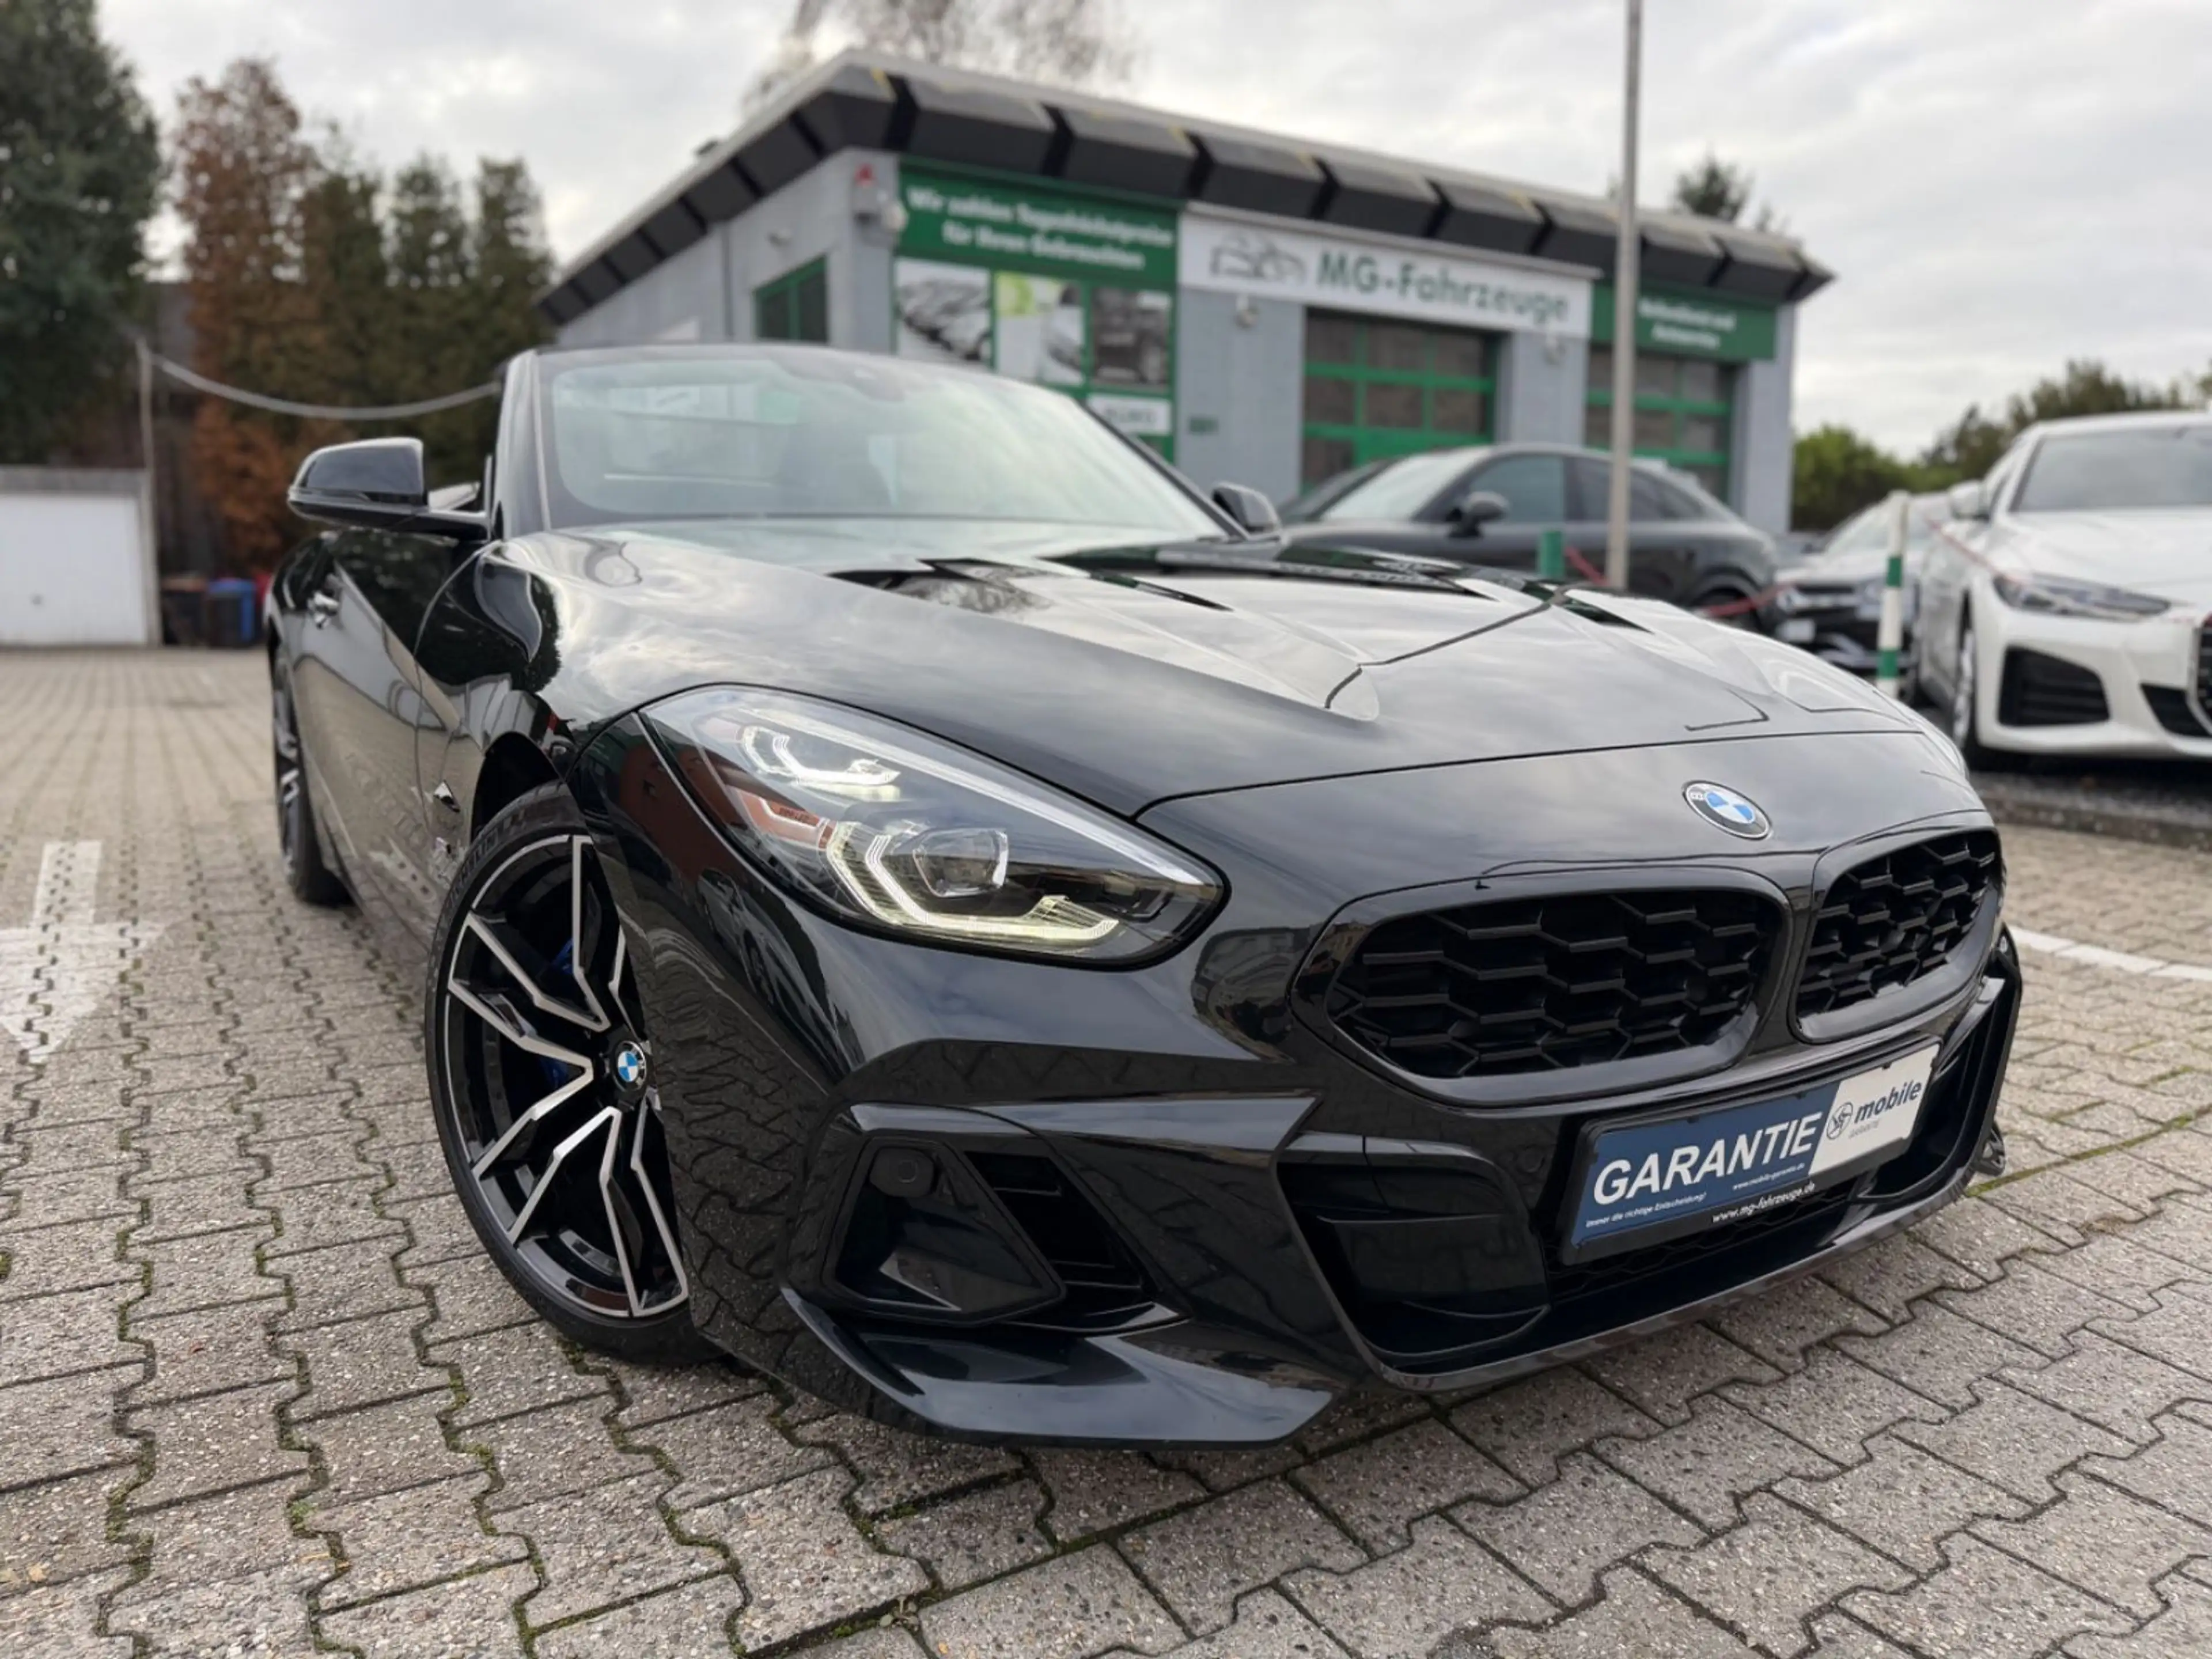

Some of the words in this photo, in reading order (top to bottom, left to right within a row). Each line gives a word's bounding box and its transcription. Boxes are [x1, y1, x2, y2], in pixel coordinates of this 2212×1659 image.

[1316, 250, 1569, 324] MG-Fahrzeuge
[1854, 1080, 1922, 1124] mobile
[1594, 1111, 1824, 1206] GARANTIE
